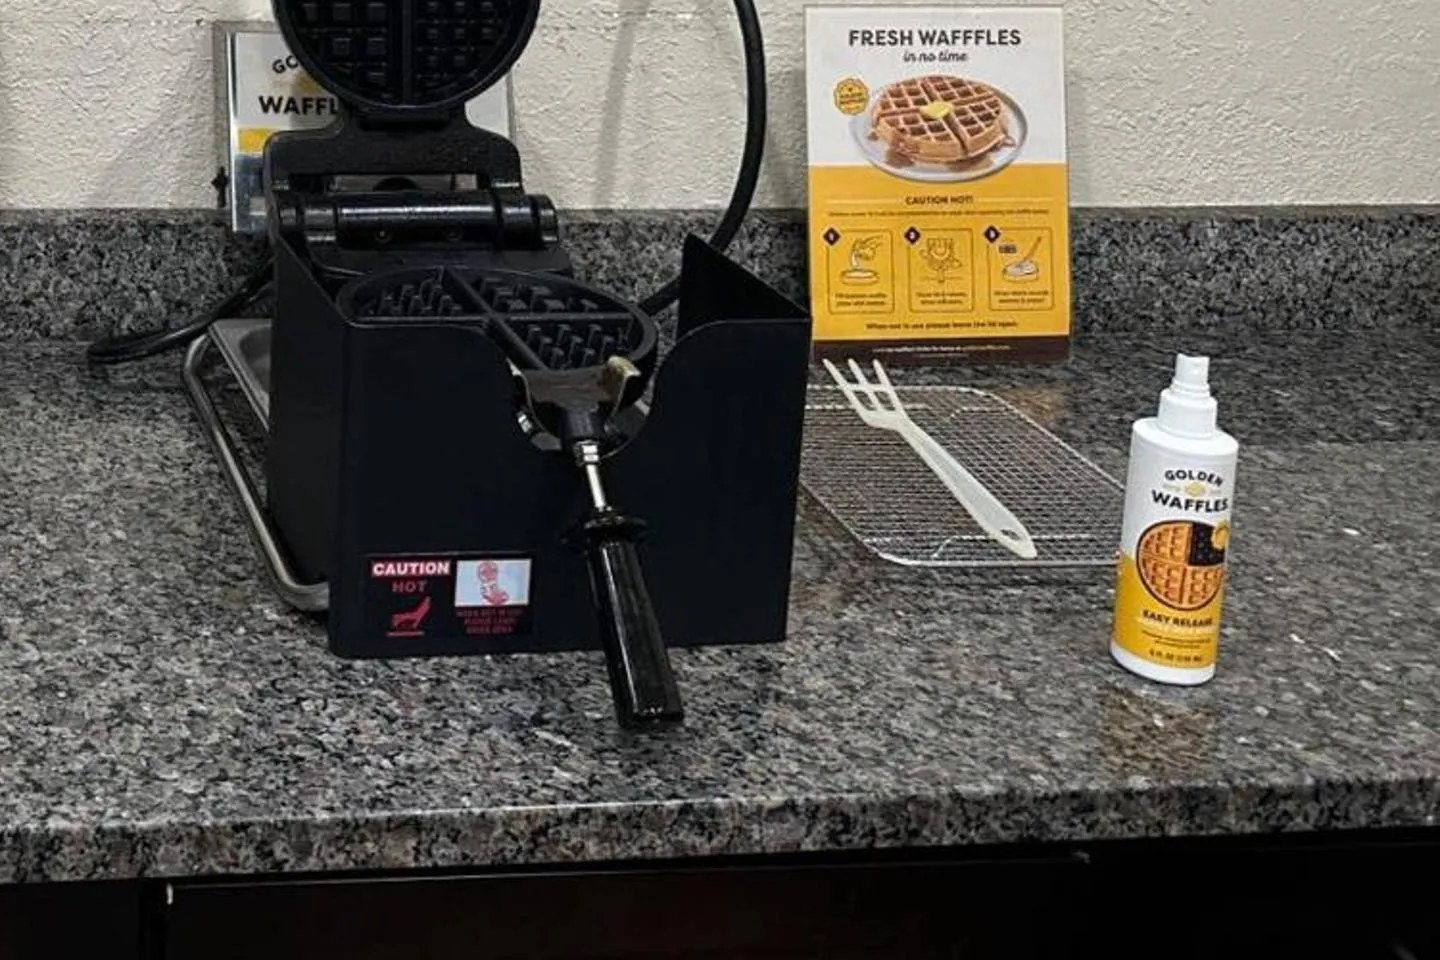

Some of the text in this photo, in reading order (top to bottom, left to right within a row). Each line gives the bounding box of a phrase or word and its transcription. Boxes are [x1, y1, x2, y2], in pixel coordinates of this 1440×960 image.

[848, 29, 914, 46] FRESH
[919, 53, 936, 63] no
[938, 50, 968, 63] time
[1164, 469, 1223, 488] GOLDEN
[1151, 489, 1229, 513] WAFFLES
[372, 561, 450, 576] CAUTION
[392, 580, 428, 594] HOT
